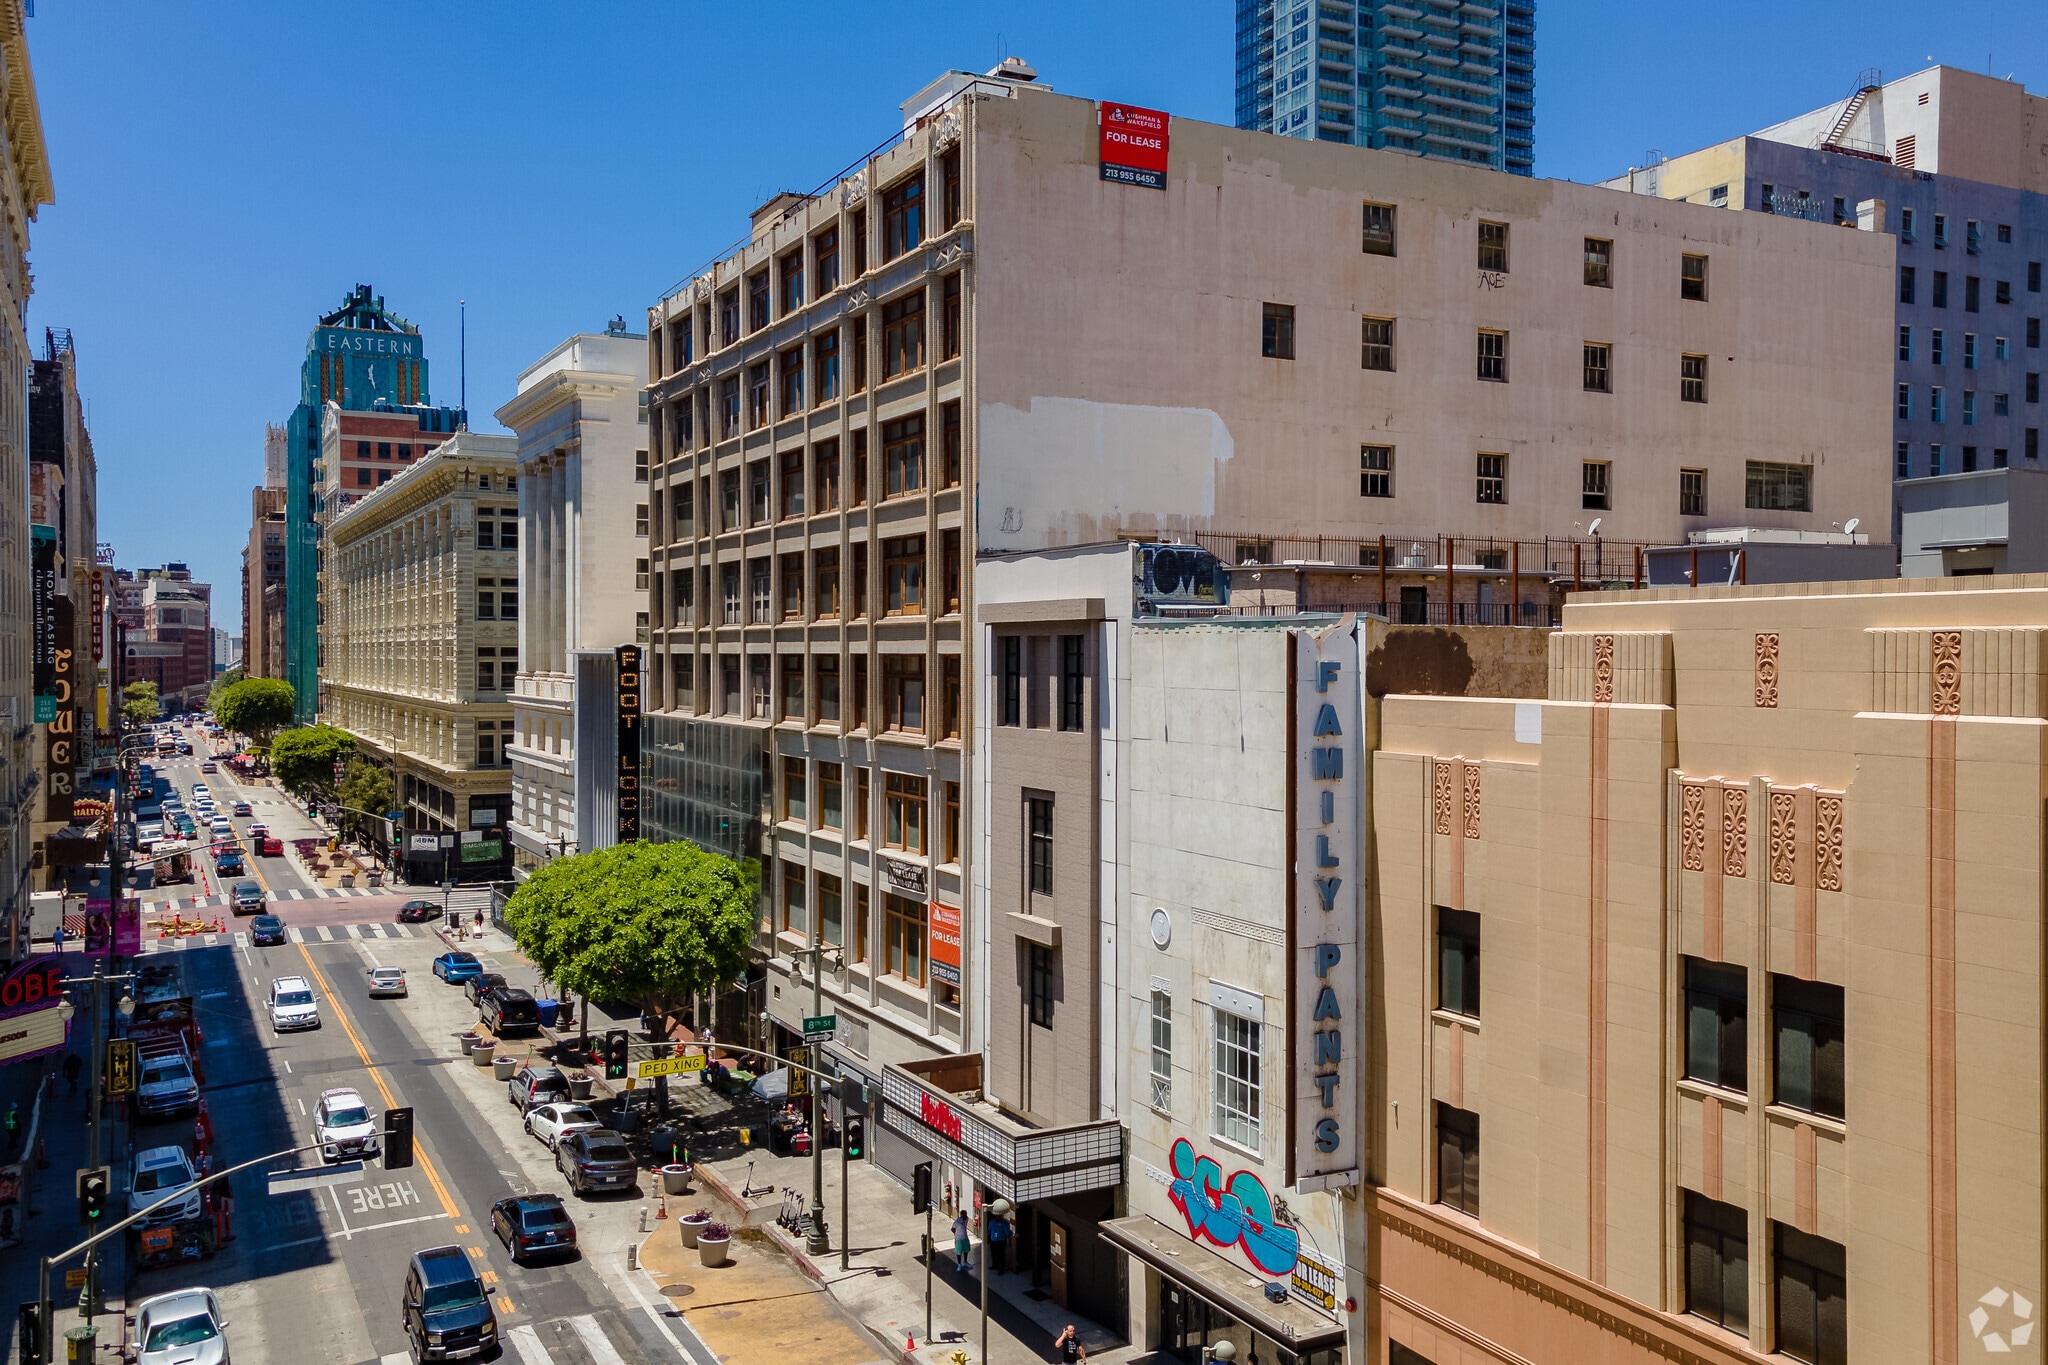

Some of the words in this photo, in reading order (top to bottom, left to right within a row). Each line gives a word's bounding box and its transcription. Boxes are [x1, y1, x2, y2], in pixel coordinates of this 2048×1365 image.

[1126, 112, 1156, 122] CUSHMAN
[1127, 118, 1161, 130] WAKEFIELD
[1106, 131, 1127, 143] FOR
[1130, 135, 1161, 149] LEASE
[1105, 168, 1118, 178] 213
[1120, 170, 1134, 180] 955
[1135, 173, 1156, 184] 6450
[328, 335, 412, 354] EASTERN
[46, 570, 54, 600] NOW
[36, 569, 44, 664] chapmanflats.com
[92, 582, 101, 656] ORPHEUM
[46, 607, 54, 664] LEASING
[620, 651, 638, 728] FOOT
[1313, 660, 1343, 912] FAMILY
[931, 930, 942, 942] FOR
[943, 933, 960, 947] LEASE
[1313, 944, 1343, 1155] PANTS
[644, 1062, 668, 1075] PED
[673, 1058, 700, 1071] XING
[346, 1180, 421, 1214] HERE
[1308, 1265, 1335, 1296] LEASE
